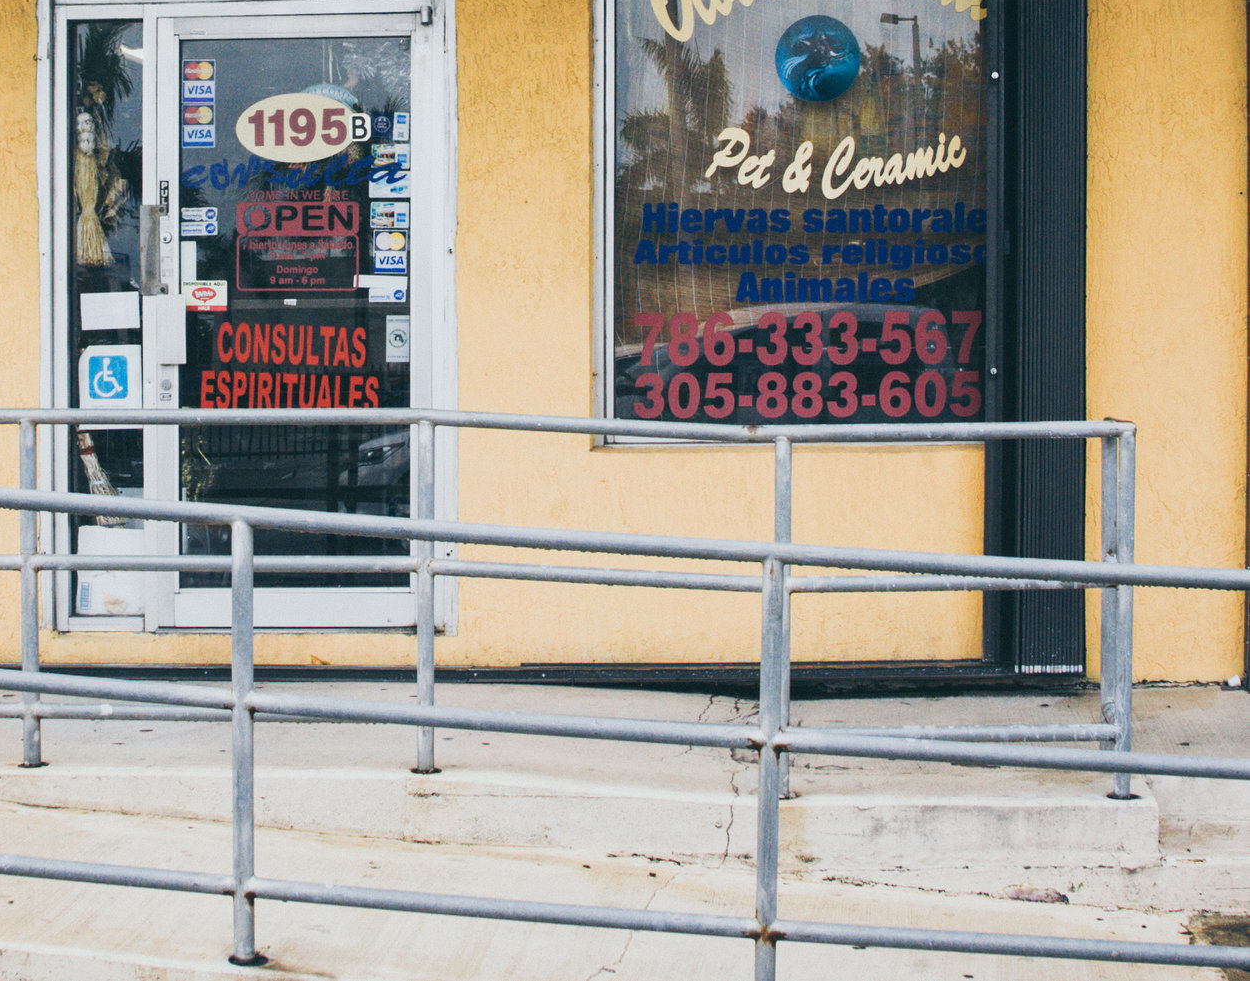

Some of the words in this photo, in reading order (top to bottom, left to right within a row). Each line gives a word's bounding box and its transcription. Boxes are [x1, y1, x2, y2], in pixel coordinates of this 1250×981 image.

[187, 85, 212, 95] VISA
[187, 129, 212, 139] VISA
[705, 128, 776, 189] Pet
[782, 141, 814, 193] &
[821, 133, 967, 199] Ceramic
[247, 190, 282, 200] COME
[287, 190, 301, 200] IN
[303, 190, 321, 200] WE
[324, 190, 349, 200] ARE
[244, 205, 353, 231] OPEN
[642, 203, 791, 233] Hiervas
[379, 256, 405, 266] VISA
[276, 265, 319, 276] Domingo
[310, 278, 325, 286] pm
[735, 272, 916, 303] Animales
[217, 322, 366, 368] CONSULTAS
[201, 370, 379, 408] ESPIRITUALES
